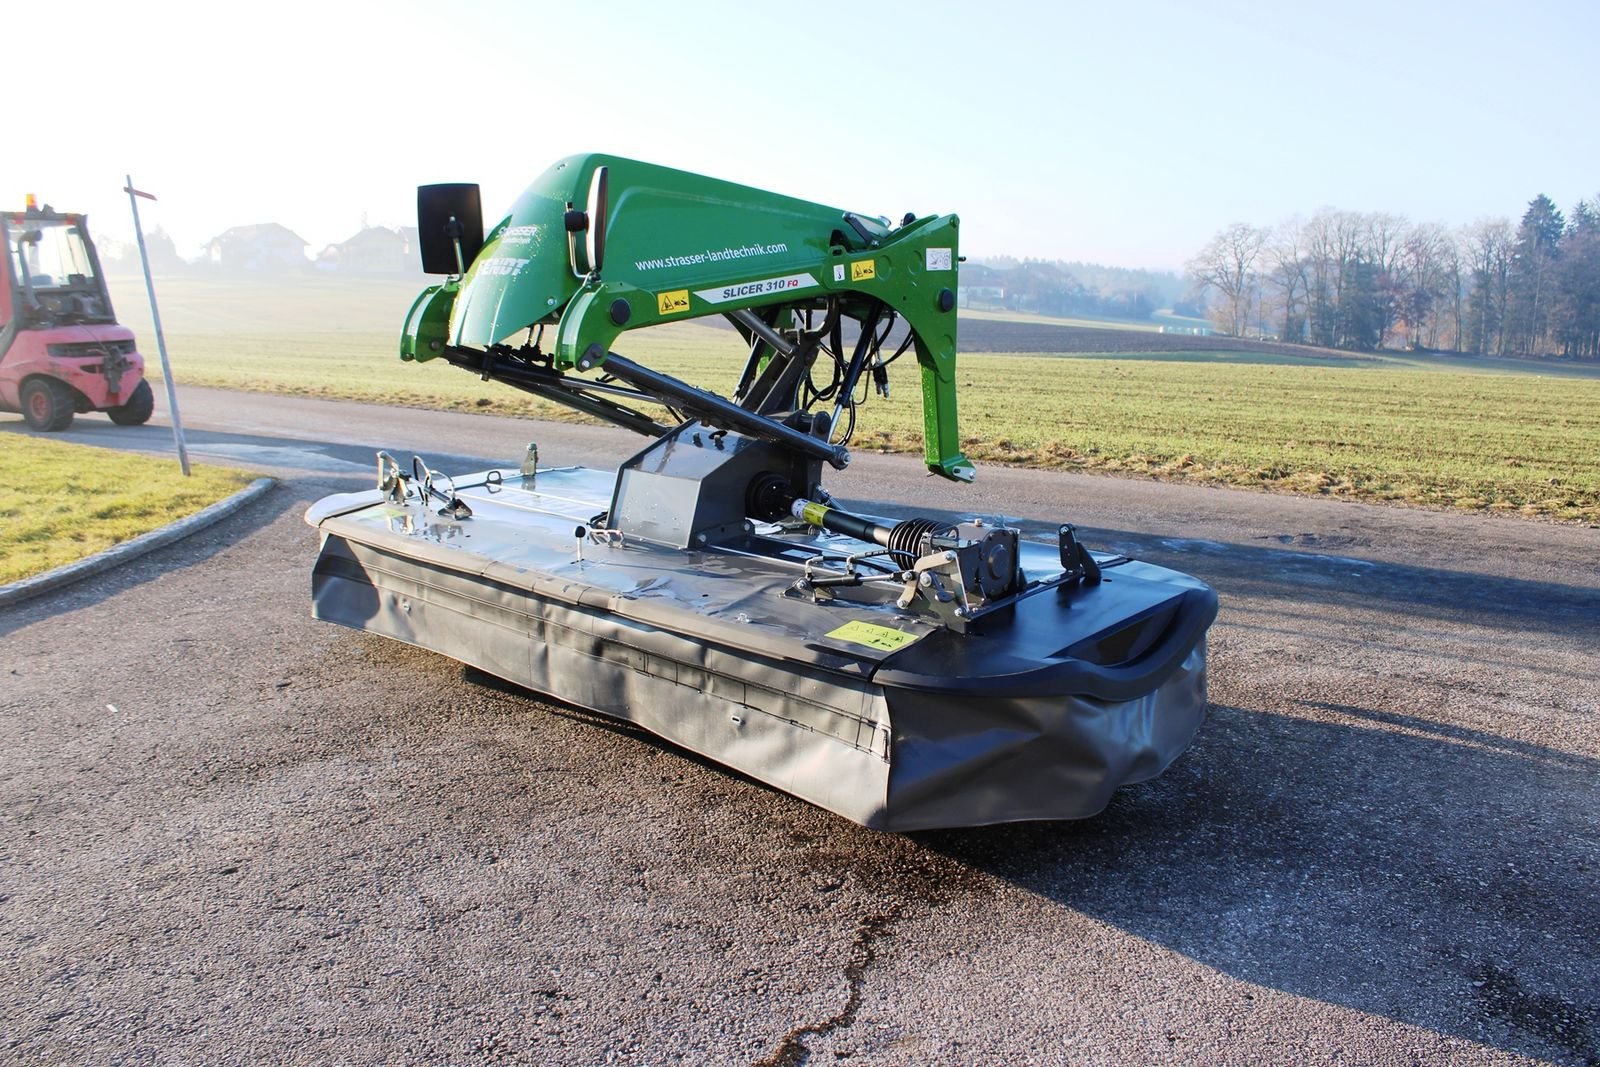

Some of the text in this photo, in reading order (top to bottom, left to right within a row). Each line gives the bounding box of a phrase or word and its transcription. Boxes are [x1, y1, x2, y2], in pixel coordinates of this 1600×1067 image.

[635, 242, 788, 271] www.strasser-landtechnik.com
[723, 279, 798, 299] SLICER 310 FQ
